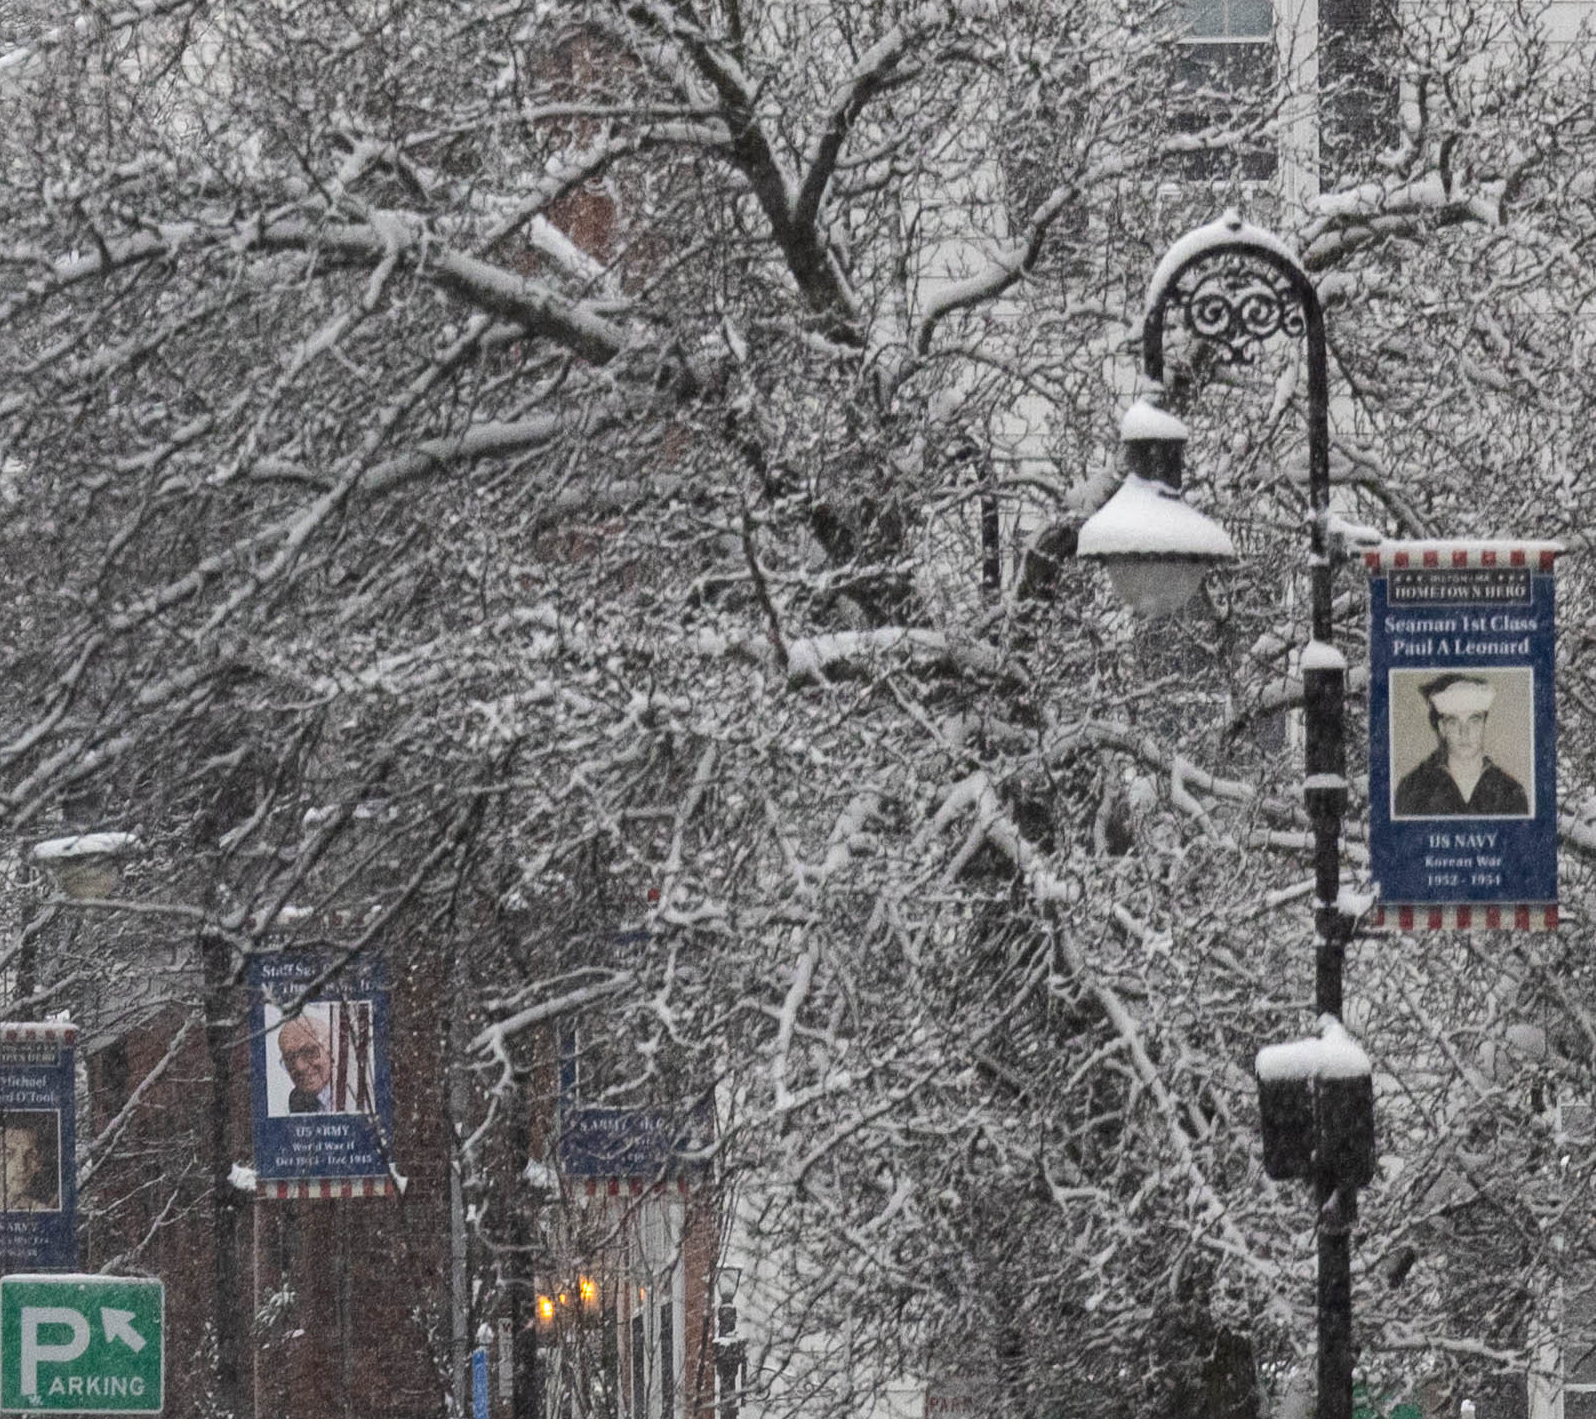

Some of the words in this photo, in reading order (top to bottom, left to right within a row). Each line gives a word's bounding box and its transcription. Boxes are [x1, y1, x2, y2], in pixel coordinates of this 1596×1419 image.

[1395, 585, 1481, 599] HOMETOWN
[1484, 584, 1527, 599] HERO
[1385, 615, 1456, 632] Seaman
[1463, 615, 1486, 632] 1st
[1490, 614, 1538, 632] Class
[1393, 638, 1433, 656] Paul
[1436, 639, 1450, 656] A
[1454, 637, 1530, 656] Leonard
[1429, 834, 1446, 849] US
[1454, 832, 1498, 849] NAVY
[1425, 855, 1473, 868] Korean
[1476, 855, 1502, 868] War
[262, 963, 294, 978] Staff
[16, 1091, 61, 1103] O'Tool
[296, 1125, 312, 1138] US
[293, 1141, 322, 1152] Word
[323, 1141, 346, 1151] War
